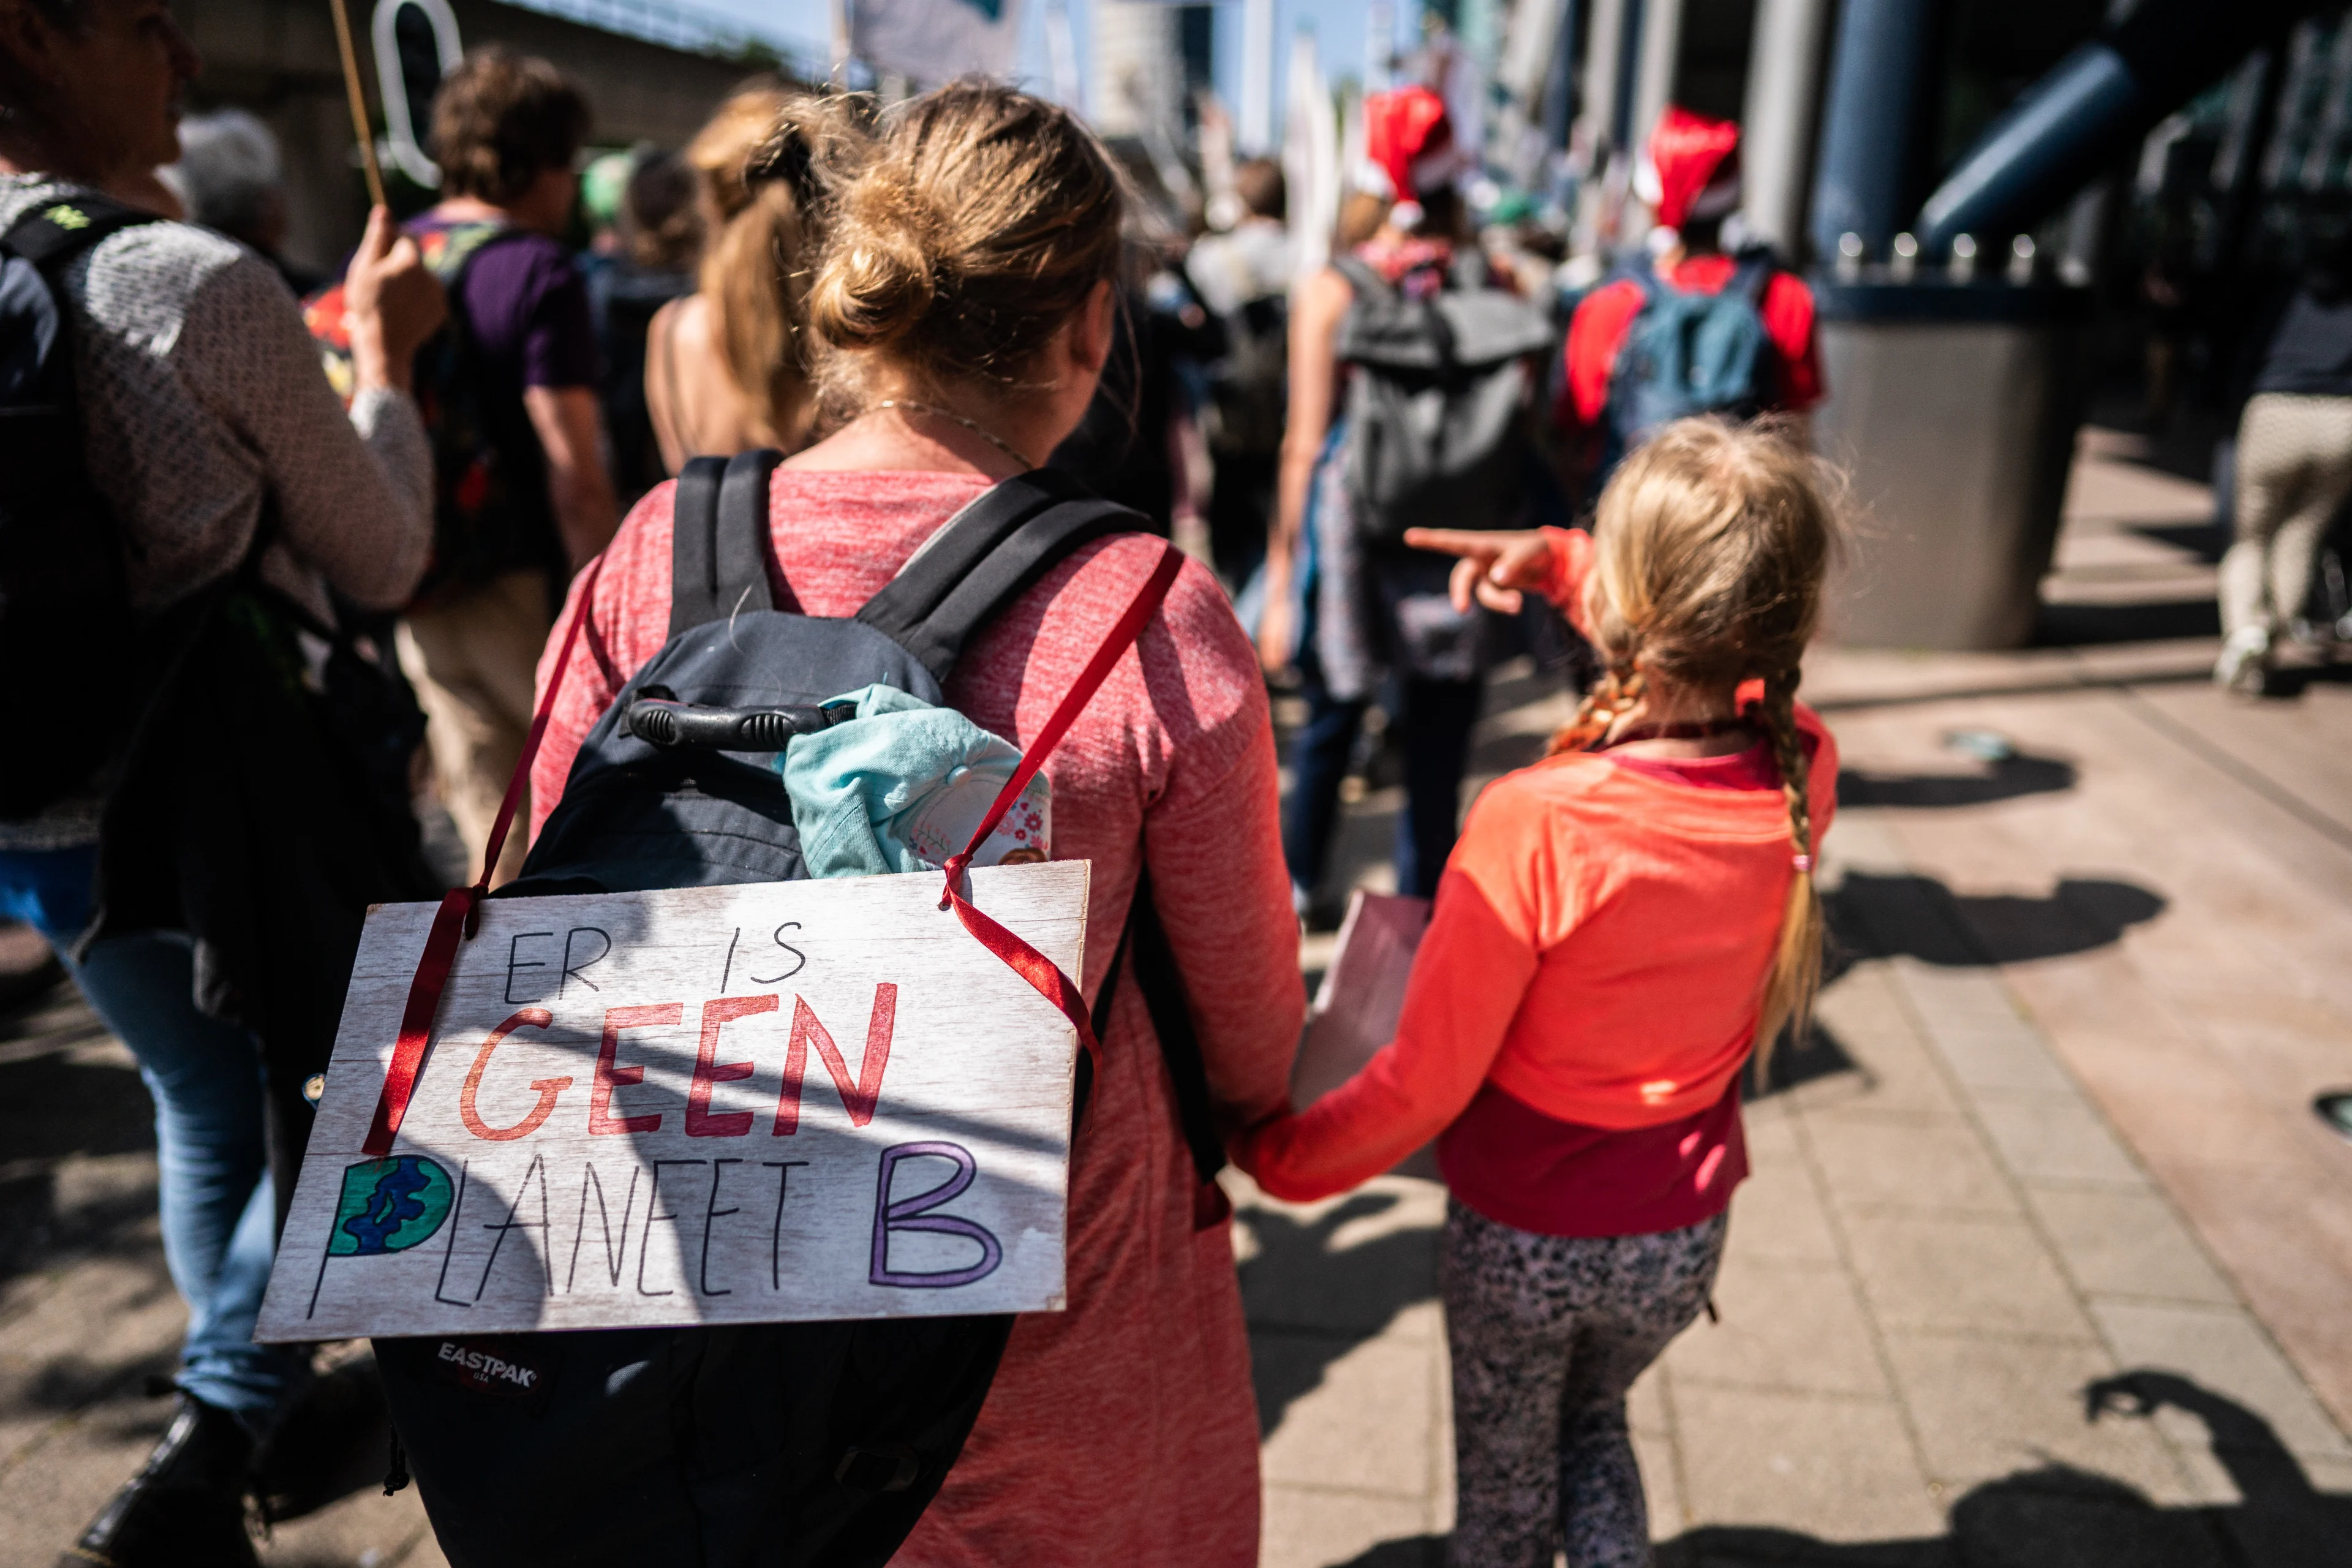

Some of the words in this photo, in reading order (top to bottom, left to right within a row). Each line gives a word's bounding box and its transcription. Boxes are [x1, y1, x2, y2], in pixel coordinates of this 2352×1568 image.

[505, 924, 612, 1004] ER
[721, 921, 806, 993] IS
[460, 982, 897, 1140] GEEN
[307, 1153, 809, 1319] PLANEET
[870, 1140, 1003, 1287] B
[473, 1372, 489, 1382] USA
